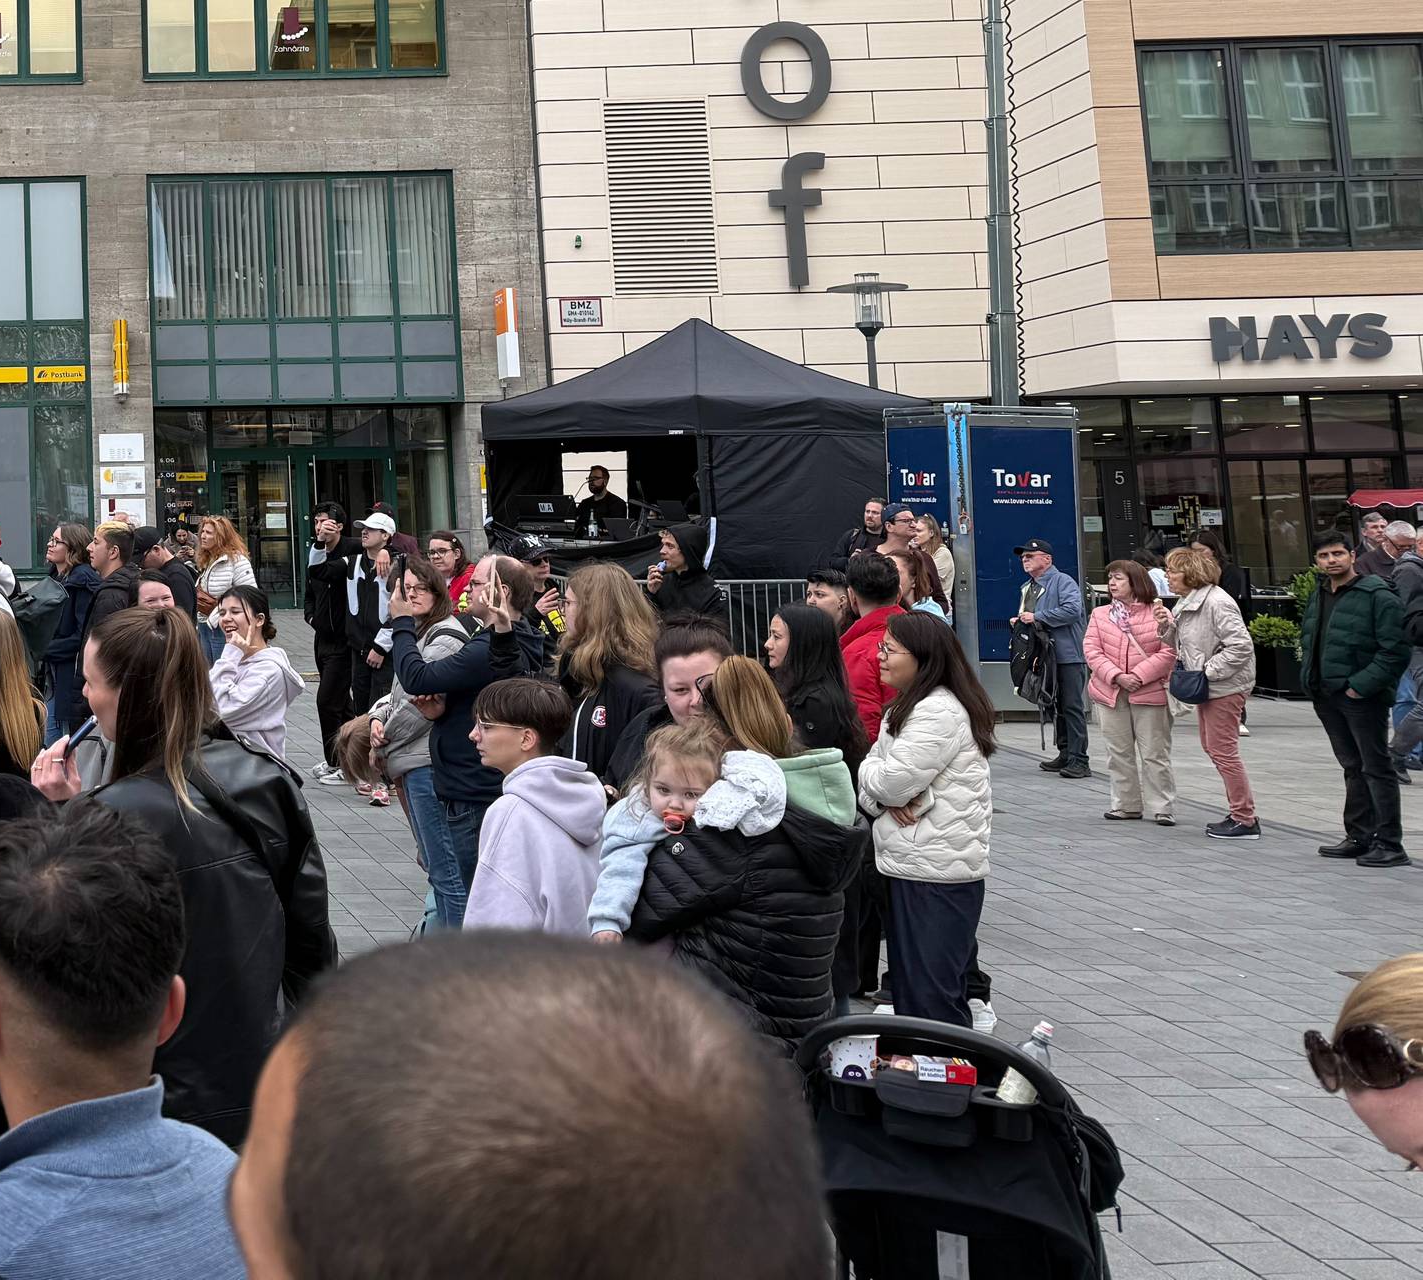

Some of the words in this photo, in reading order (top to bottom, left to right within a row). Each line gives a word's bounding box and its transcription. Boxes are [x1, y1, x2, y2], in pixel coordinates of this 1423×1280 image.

[570, 301, 592, 310] BMZ
[1208, 312, 1393, 362] HAYS
[51, 370, 82, 378] Postbank
[900, 468, 936, 487] Tovar
[991, 468, 1052, 488] Tovar
[1114, 470, 1125, 485] 5
